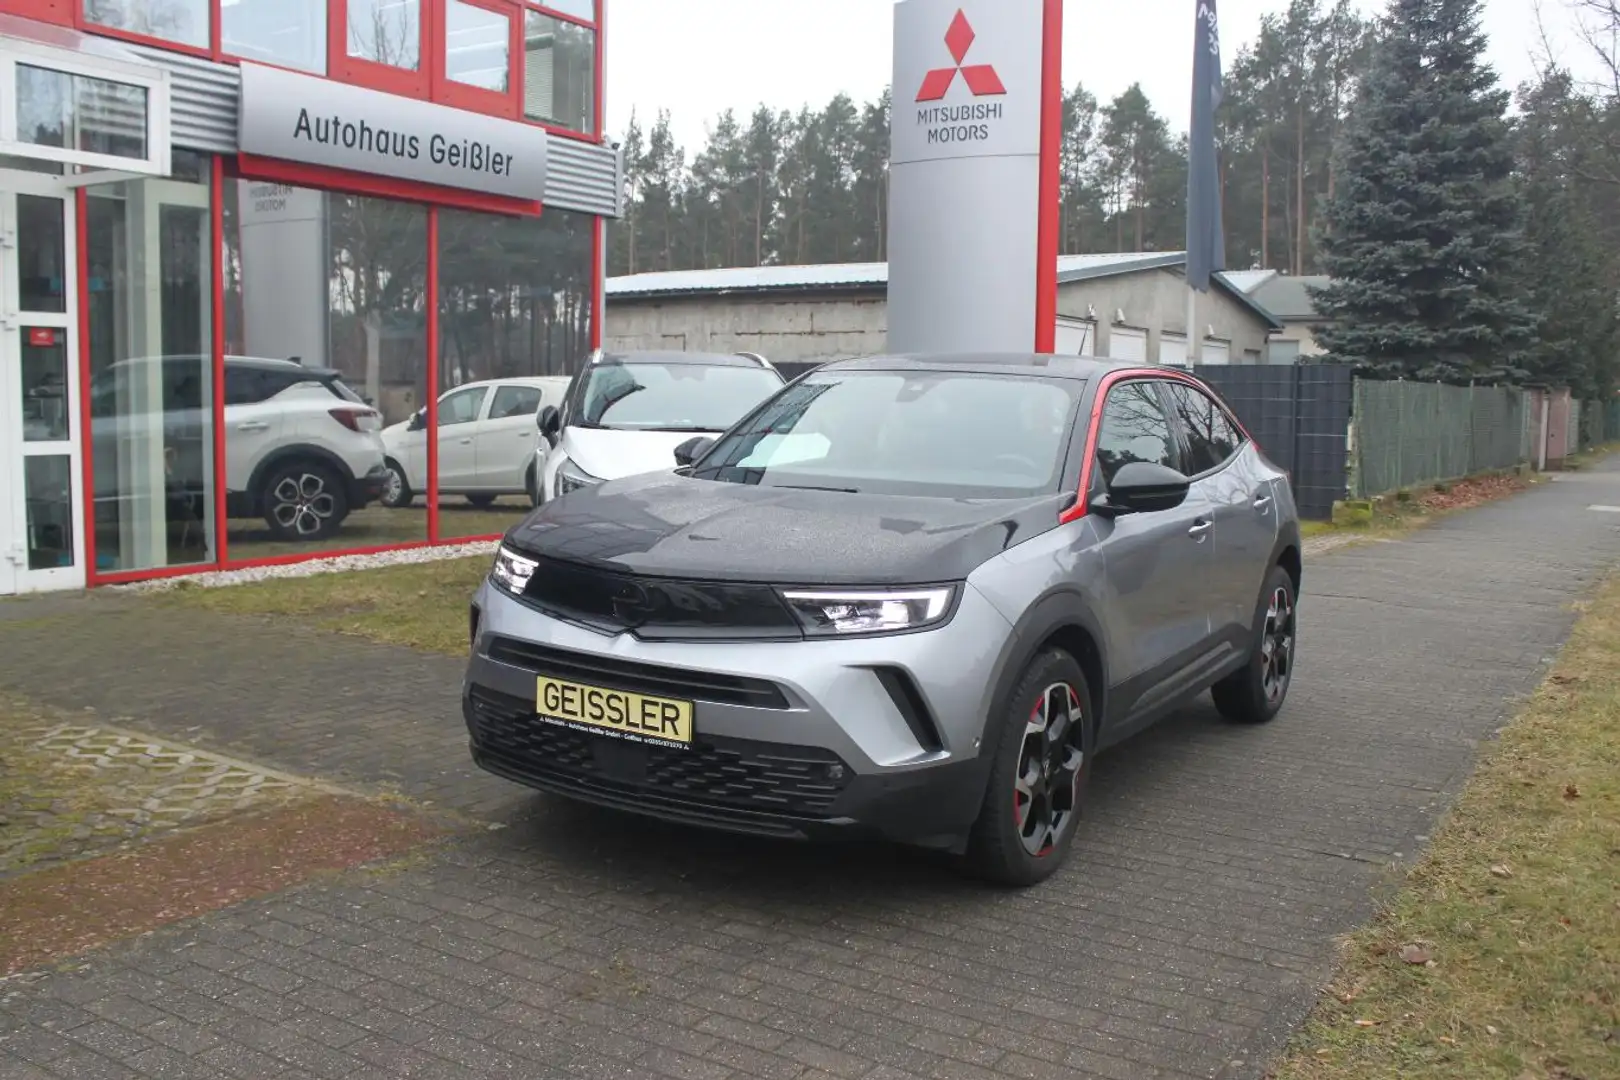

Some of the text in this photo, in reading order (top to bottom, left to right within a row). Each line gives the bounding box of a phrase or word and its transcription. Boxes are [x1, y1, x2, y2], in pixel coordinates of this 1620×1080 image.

[917, 103, 1002, 125] MITSUBISHI
[293, 107, 513, 176] Autohaus Geißler
[928, 124, 989, 144] MOTORS
[543, 682, 681, 735] GEISSLER
